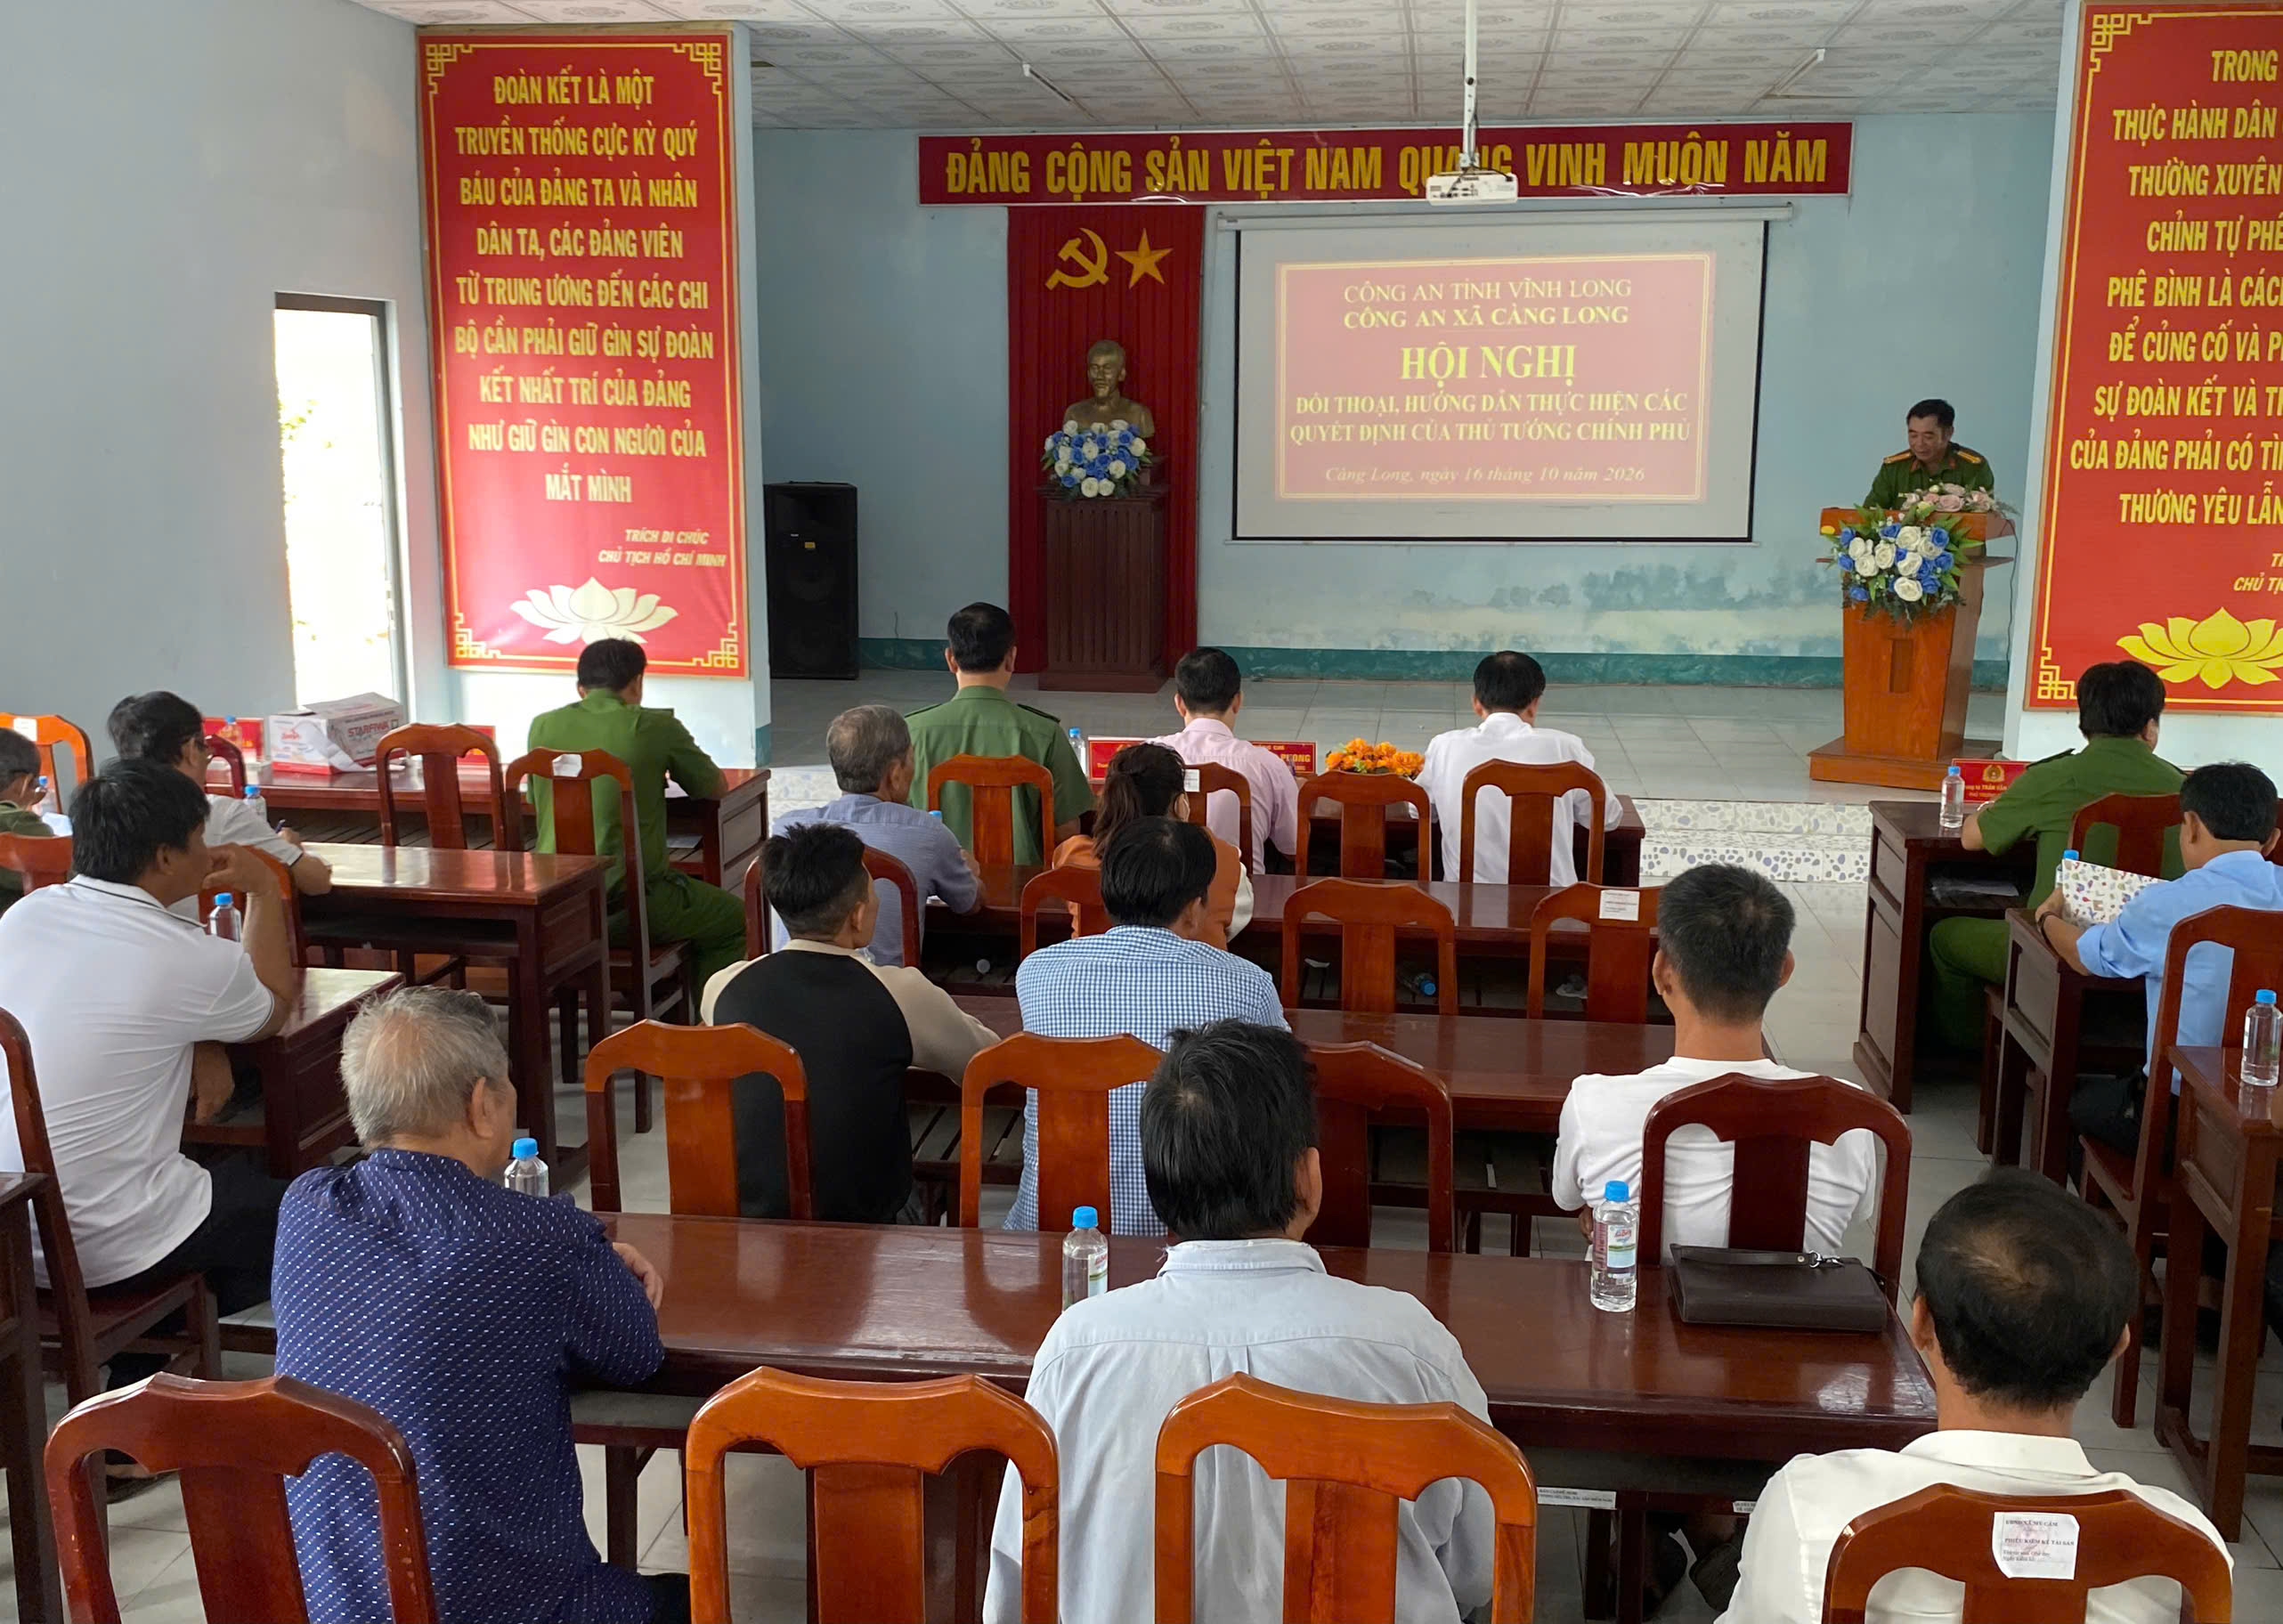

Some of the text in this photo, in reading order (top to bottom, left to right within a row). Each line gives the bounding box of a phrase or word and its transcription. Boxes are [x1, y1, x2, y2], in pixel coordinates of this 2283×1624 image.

[2211, 50, 2279, 82] TRONG
[493, 64, 654, 110] ĐOÀN KẾT LÀ MỘT
[455, 116, 698, 161] TRUYỀN THỐNG CỰC KỲ QUÝ
[2112, 99, 2278, 147] THỰC HÀNH DÂN
[947, 137, 1030, 193] ĐẢNG
[1046, 142, 1132, 201] CỘNG
[1145, 134, 1210, 192] SẢN
[1223, 138, 1295, 199] VIỆT
[1305, 147, 1382, 191] NAM
[1526, 142, 1606, 186] VINH
[1623, 130, 1727, 185] MUÔN
[1744, 131, 1827, 183] NĂM
[2129, 155, 2283, 197] THƯỜNG XUYÊN
[459, 167, 698, 207] BÁU CỦA ĐẢNG TA VÀ NHÂN
[476, 218, 683, 260] DÂN TA, CÁC ĐẢNG VIÊN
[2147, 210, 2208, 252] CHỈNH
[2214, 215, 2244, 258] TỰ
[456, 269, 709, 309] TỪ TRUNG ƯƠNG ĐẾN CÁC CHI
[1344, 280, 1406, 303] CÔNG
[1412, 283, 1443, 302] AN
[1508, 277, 1562, 298] VĨNH
[1570, 279, 1632, 298] LONG
[2107, 269, 2147, 307] PHÊ
[2153, 268, 2203, 307] BÌNH
[2207, 268, 2232, 307] LÀ
[1344, 305, 1407, 329] CÔNG
[1415, 309, 1446, 327] AN
[1453, 304, 1484, 327] XÃ
[1563, 305, 1629, 324] LONG
[455, 315, 713, 362] BỘ CẦN PHẢI GIỮ GÌN SỰ ĐOÀN
[2108, 315, 2140, 361] ĐỂ
[2142, 320, 2196, 361] CỦNG
[2202, 319, 2233, 361] CỐ
[2236, 323, 2260, 361] VÀ
[1401, 341, 1578, 388] HỘI NGHỊ
[479, 365, 691, 409] KẾT NHẤT TRÍ CỦA ĐẢNG
[1526, 391, 1584, 416] THỰC
[1588, 391, 1638, 416] HIỆN
[1645, 388, 1688, 411] CÁC
[2093, 380, 2123, 422] SỰ
[2125, 378, 2181, 417] ĐOÀN
[2186, 374, 2227, 417] KẾT
[2232, 378, 2257, 417] VÀ
[467, 418, 505, 451] NHƯ
[508, 418, 538, 451] GIỮ
[541, 418, 571, 452] GÌN
[574, 426, 610, 454] CON
[670, 418, 706, 458] CỦA
[1577, 418, 1643, 441] CHÍNH
[2070, 428, 2108, 470] CỦA
[2115, 428, 2168, 470] ĐẢNG
[2173, 428, 2221, 470] PHẢI
[2226, 432, 2254, 471] CÓ
[545, 462, 632, 502] MẮT MÌNH
[1540, 467, 1559, 482] 10
[1603, 467, 1645, 482] 2026
[2119, 488, 2196, 524] THƯƠNG
[2202, 486, 2242, 524] YÊU
[624, 527, 660, 542] TRÍCH
[677, 528, 710, 545] CHÚC
[625, 550, 651, 566] TỊCH
[696, 553, 727, 567] MINH
[2233, 572, 2264, 591] CHỦ
